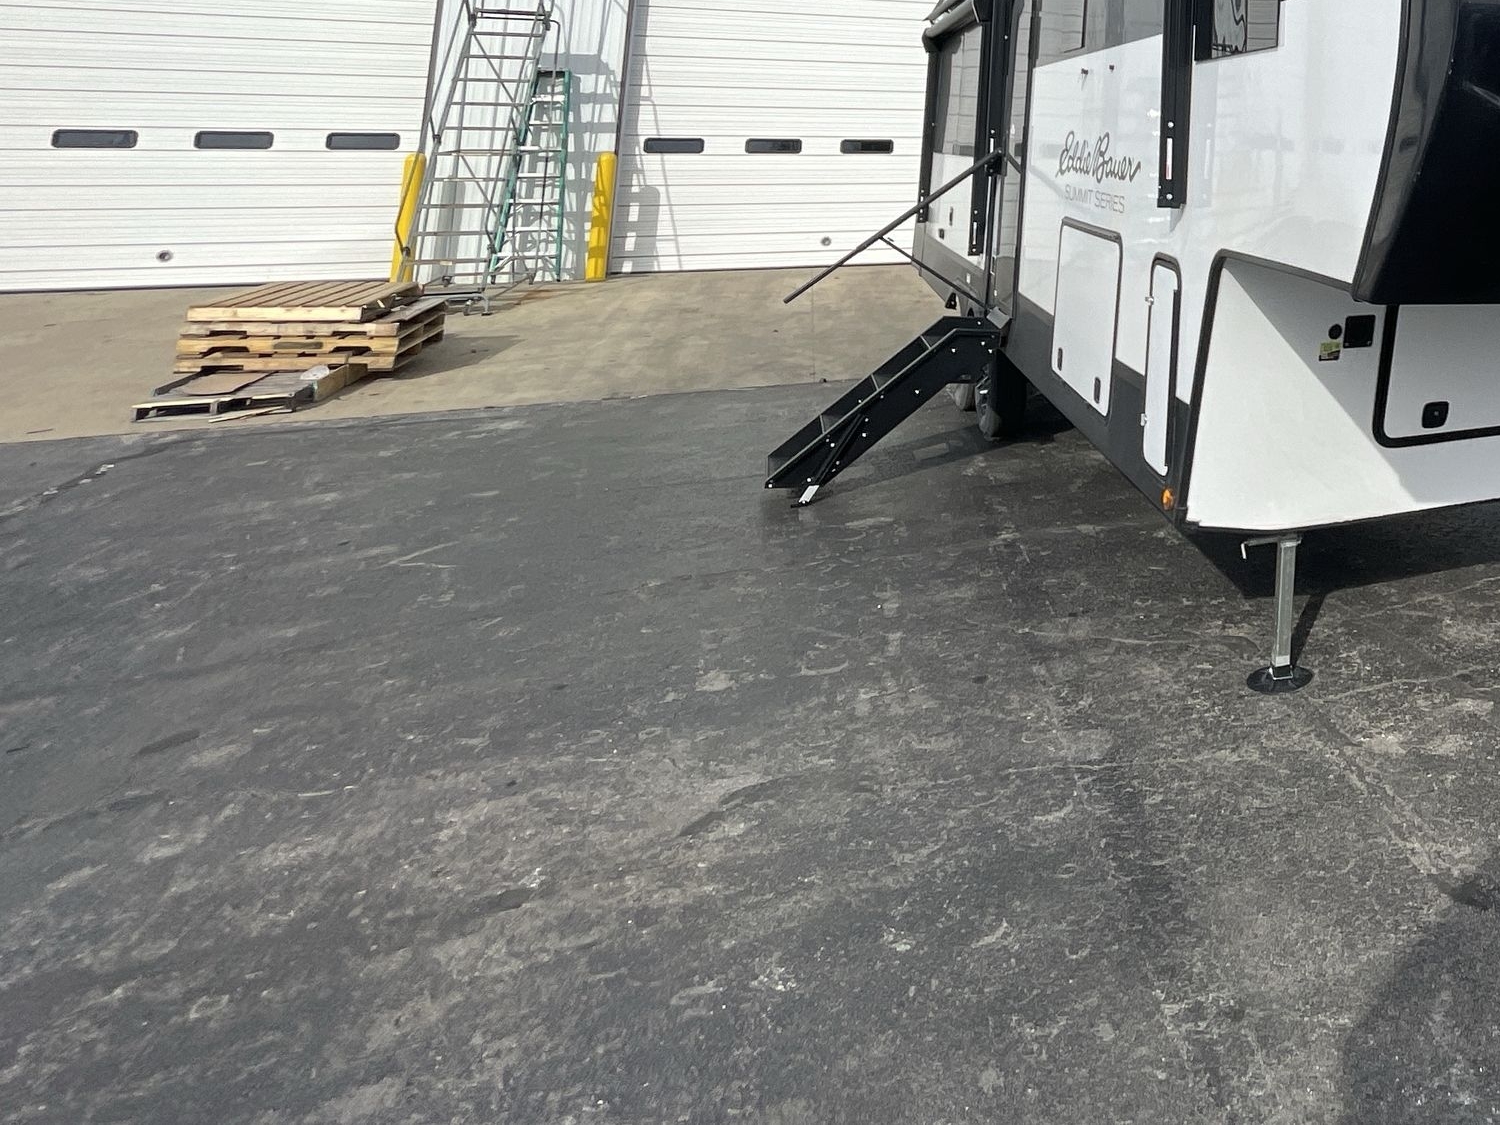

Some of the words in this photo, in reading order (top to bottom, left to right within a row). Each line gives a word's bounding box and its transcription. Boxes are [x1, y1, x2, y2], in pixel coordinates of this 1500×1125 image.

[1055, 130, 1091, 178] Eddie
[1092, 131, 1142, 184] Bauer
[1064, 183, 1094, 205] SUMMIT
[1094, 190, 1125, 214] SERIES
